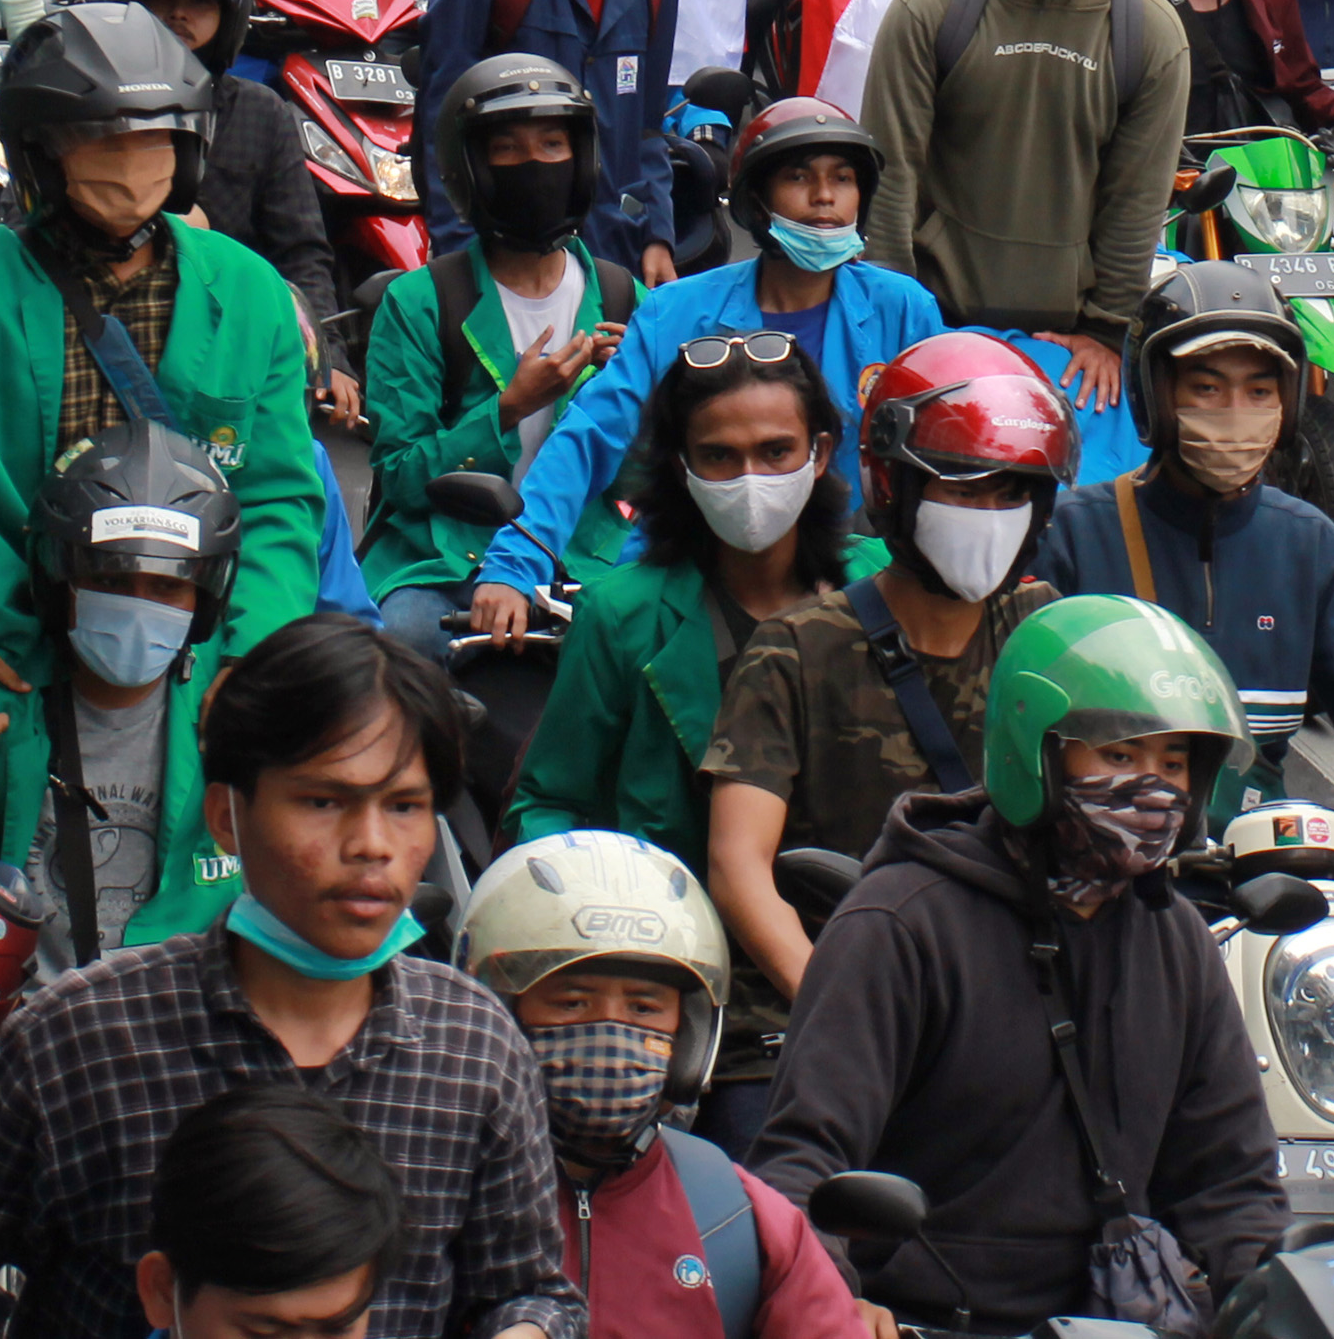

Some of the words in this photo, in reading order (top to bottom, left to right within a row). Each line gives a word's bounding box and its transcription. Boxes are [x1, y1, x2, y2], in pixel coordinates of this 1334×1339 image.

[331, 64, 343, 80] B
[353, 65, 398, 84] 3281
[118, 83, 174, 94] HONDA
[1269, 257, 1319, 275] 4346
[991, 416, 1058, 432] Cargloss
[585, 912, 658, 937] BMC
